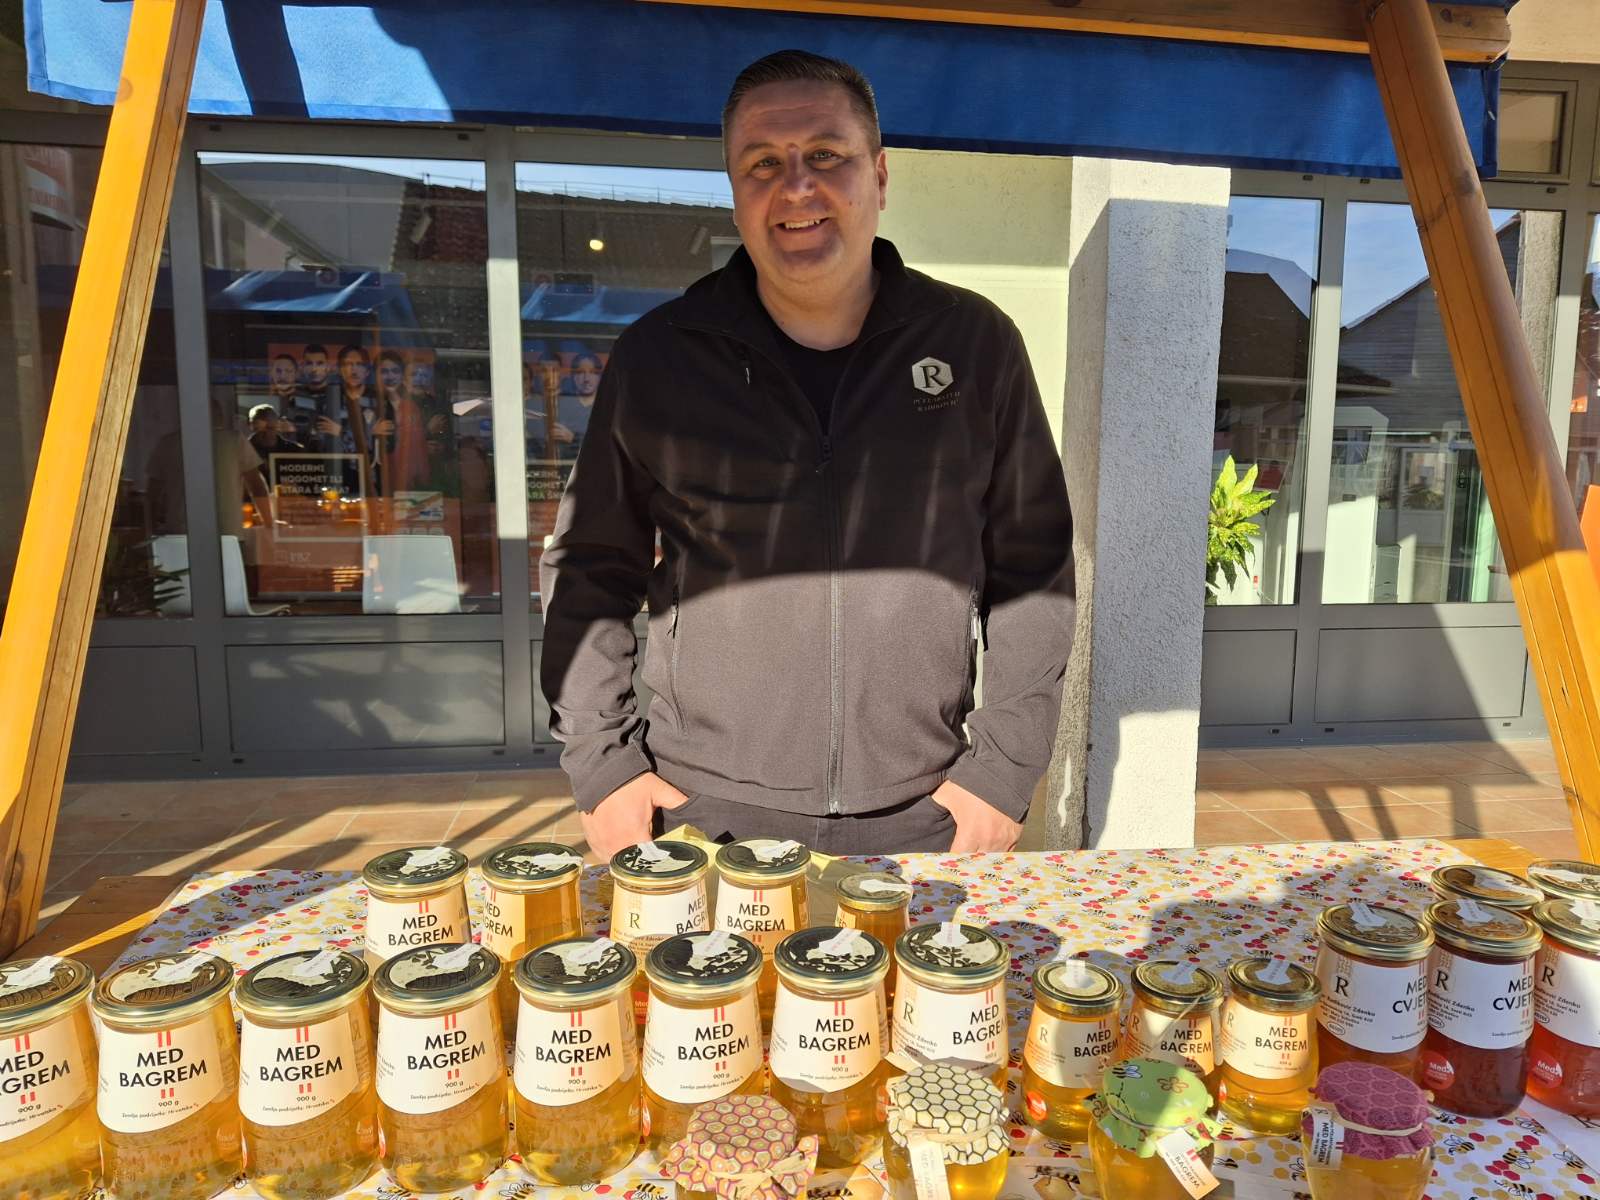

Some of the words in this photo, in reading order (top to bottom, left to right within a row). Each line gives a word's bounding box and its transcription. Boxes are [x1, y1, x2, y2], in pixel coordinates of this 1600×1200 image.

[919, 365, 948, 389] R
[280, 464, 325, 473] MODERNI
[738, 903, 770, 916] MED
[402, 914, 438, 930] MED
[483, 915, 513, 938] GREM
[628, 912, 641, 929] R
[675, 910, 706, 935] BAGR
[727, 915, 786, 932] BAGREM
[388, 925, 454, 946] BAGREM
[1434, 969, 1450, 992] R
[1507, 975, 1533, 994] MED
[1541, 965, 1555, 987] R
[1333, 975, 1349, 998] R
[903, 1001, 914, 1025] R
[969, 1003, 1000, 1025] MED
[695, 1023, 734, 1042] MED
[815, 1018, 854, 1033] MED
[1173, 1029, 1202, 1041] MED
[1268, 1026, 1298, 1038] MED
[424, 1030, 468, 1051] MED
[551, 1029, 592, 1045] MED
[798, 1031, 871, 1051] BAGREM
[1086, 1029, 1112, 1044] MED
[1255, 1036, 1308, 1052] BAGREM
[276, 1044, 321, 1063] MED
[407, 1040, 486, 1070] BAGREM
[535, 1042, 612, 1064] BAGREM
[677, 1034, 750, 1060] BAGREM
[1073, 1040, 1119, 1058] BAGREM
[1160, 1041, 1212, 1054] BAGREM
[0, 1051, 45, 1075] MED
[136, 1048, 184, 1068] MED
[0, 1060, 71, 1096] GREM
[119, 1059, 208, 1088] BAGREM
[259, 1056, 343, 1082] BAGREM
[445, 1081, 458, 1089] 900
[18, 1105, 34, 1114] 900
[158, 1100, 173, 1108] 900
